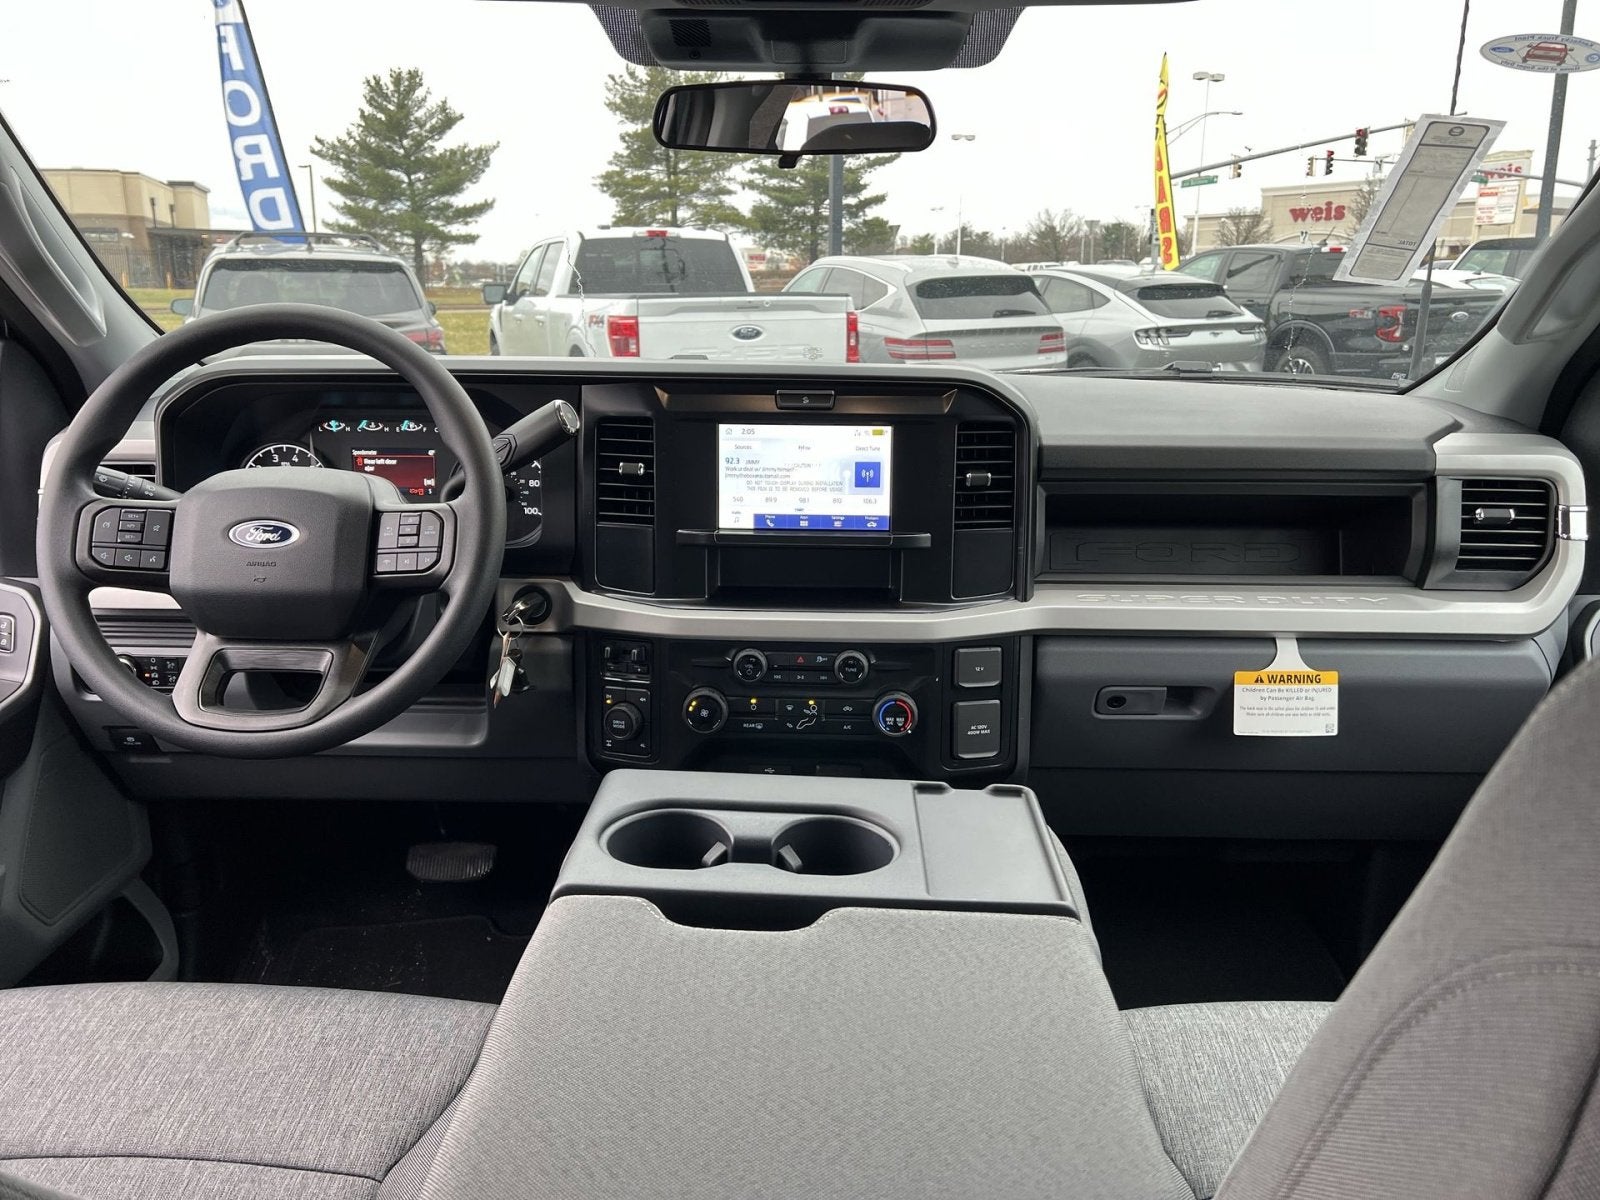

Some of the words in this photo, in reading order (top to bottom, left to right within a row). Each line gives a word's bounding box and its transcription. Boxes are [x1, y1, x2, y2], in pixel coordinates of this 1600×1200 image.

[1289, 201, 1346, 222] weis
[272, 454, 279, 463] 3
[291, 454, 299, 463] 4
[725, 457, 740, 465] 92.3
[528, 479, 540, 487] 80
[523, 507, 539, 515] 100
[1076, 594, 1246, 604] SUPER
[1257, 595, 1388, 605] DUTY
[1267, 674, 1321, 684] WARNING
